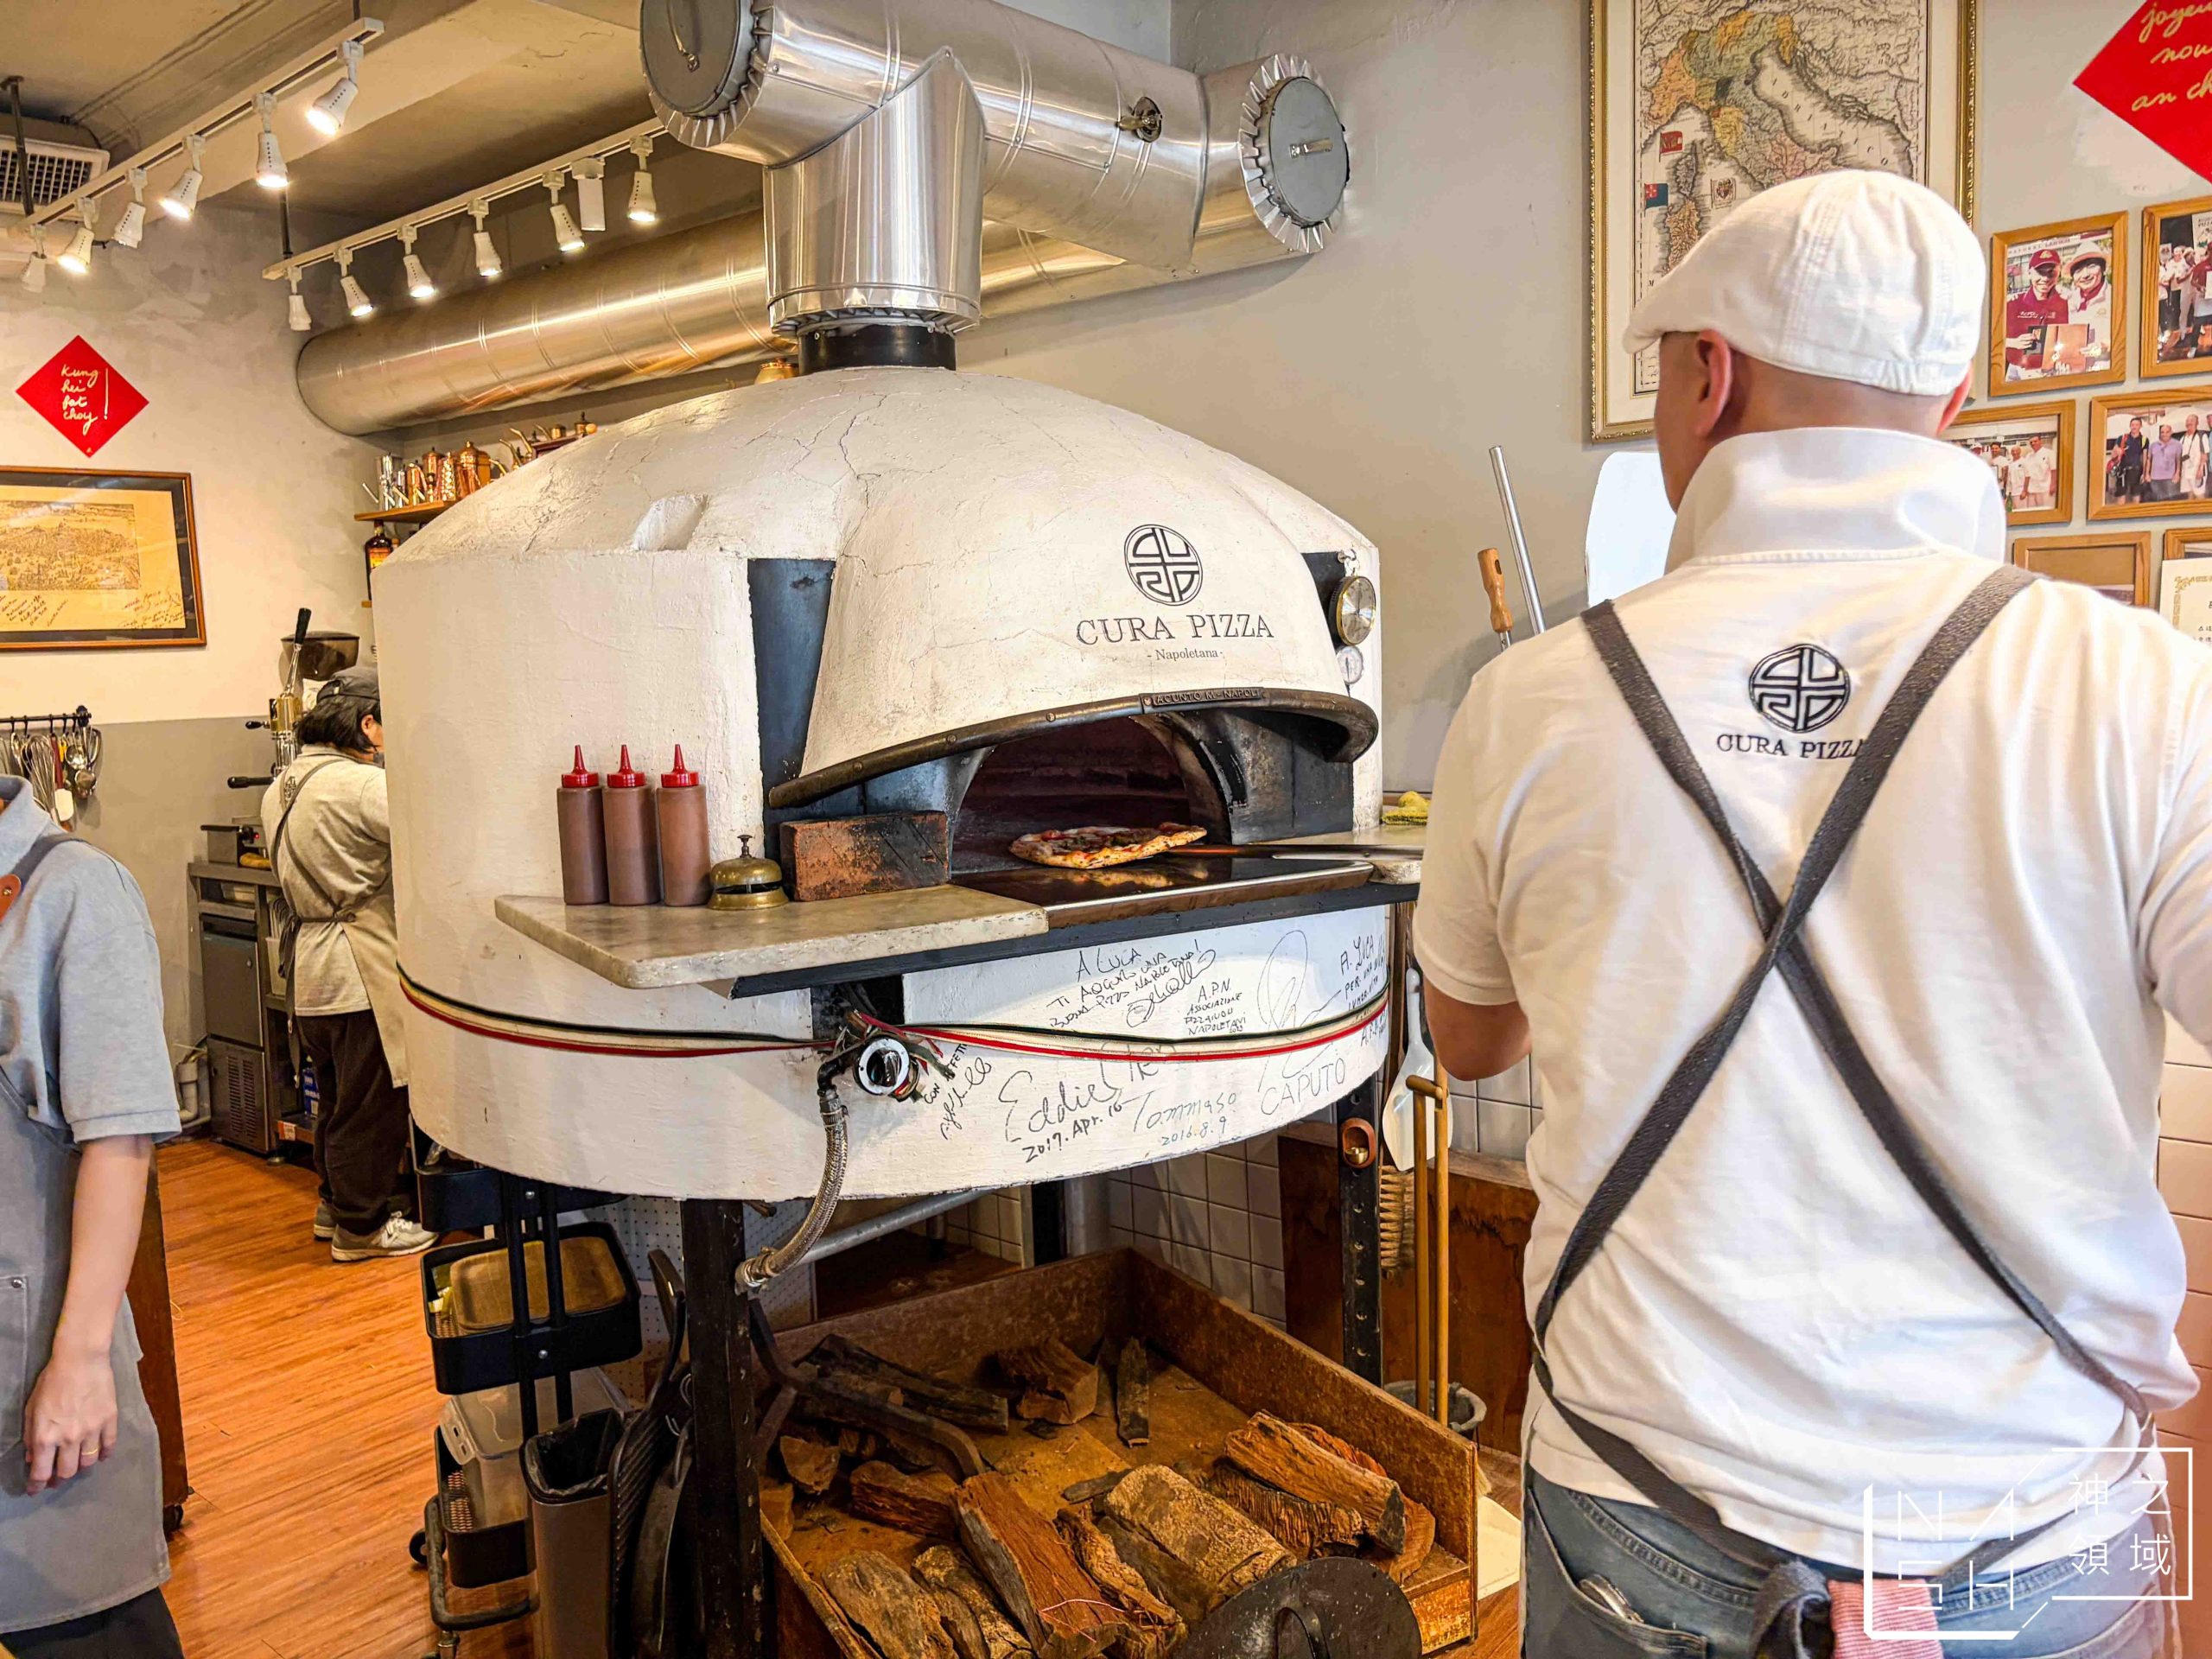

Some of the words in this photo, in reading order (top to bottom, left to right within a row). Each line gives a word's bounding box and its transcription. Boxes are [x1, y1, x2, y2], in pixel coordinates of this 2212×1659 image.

[60, 378, 86, 393] hei
[63, 409, 98, 435] choy
[1076, 615, 1175, 645] CURA
[1185, 613, 1274, 639] PIZZA
[1155, 647, 1218, 662] Napoletana
[1716, 734, 1789, 757] CURA
[1261, 1058, 1345, 1115] CAPUTO
